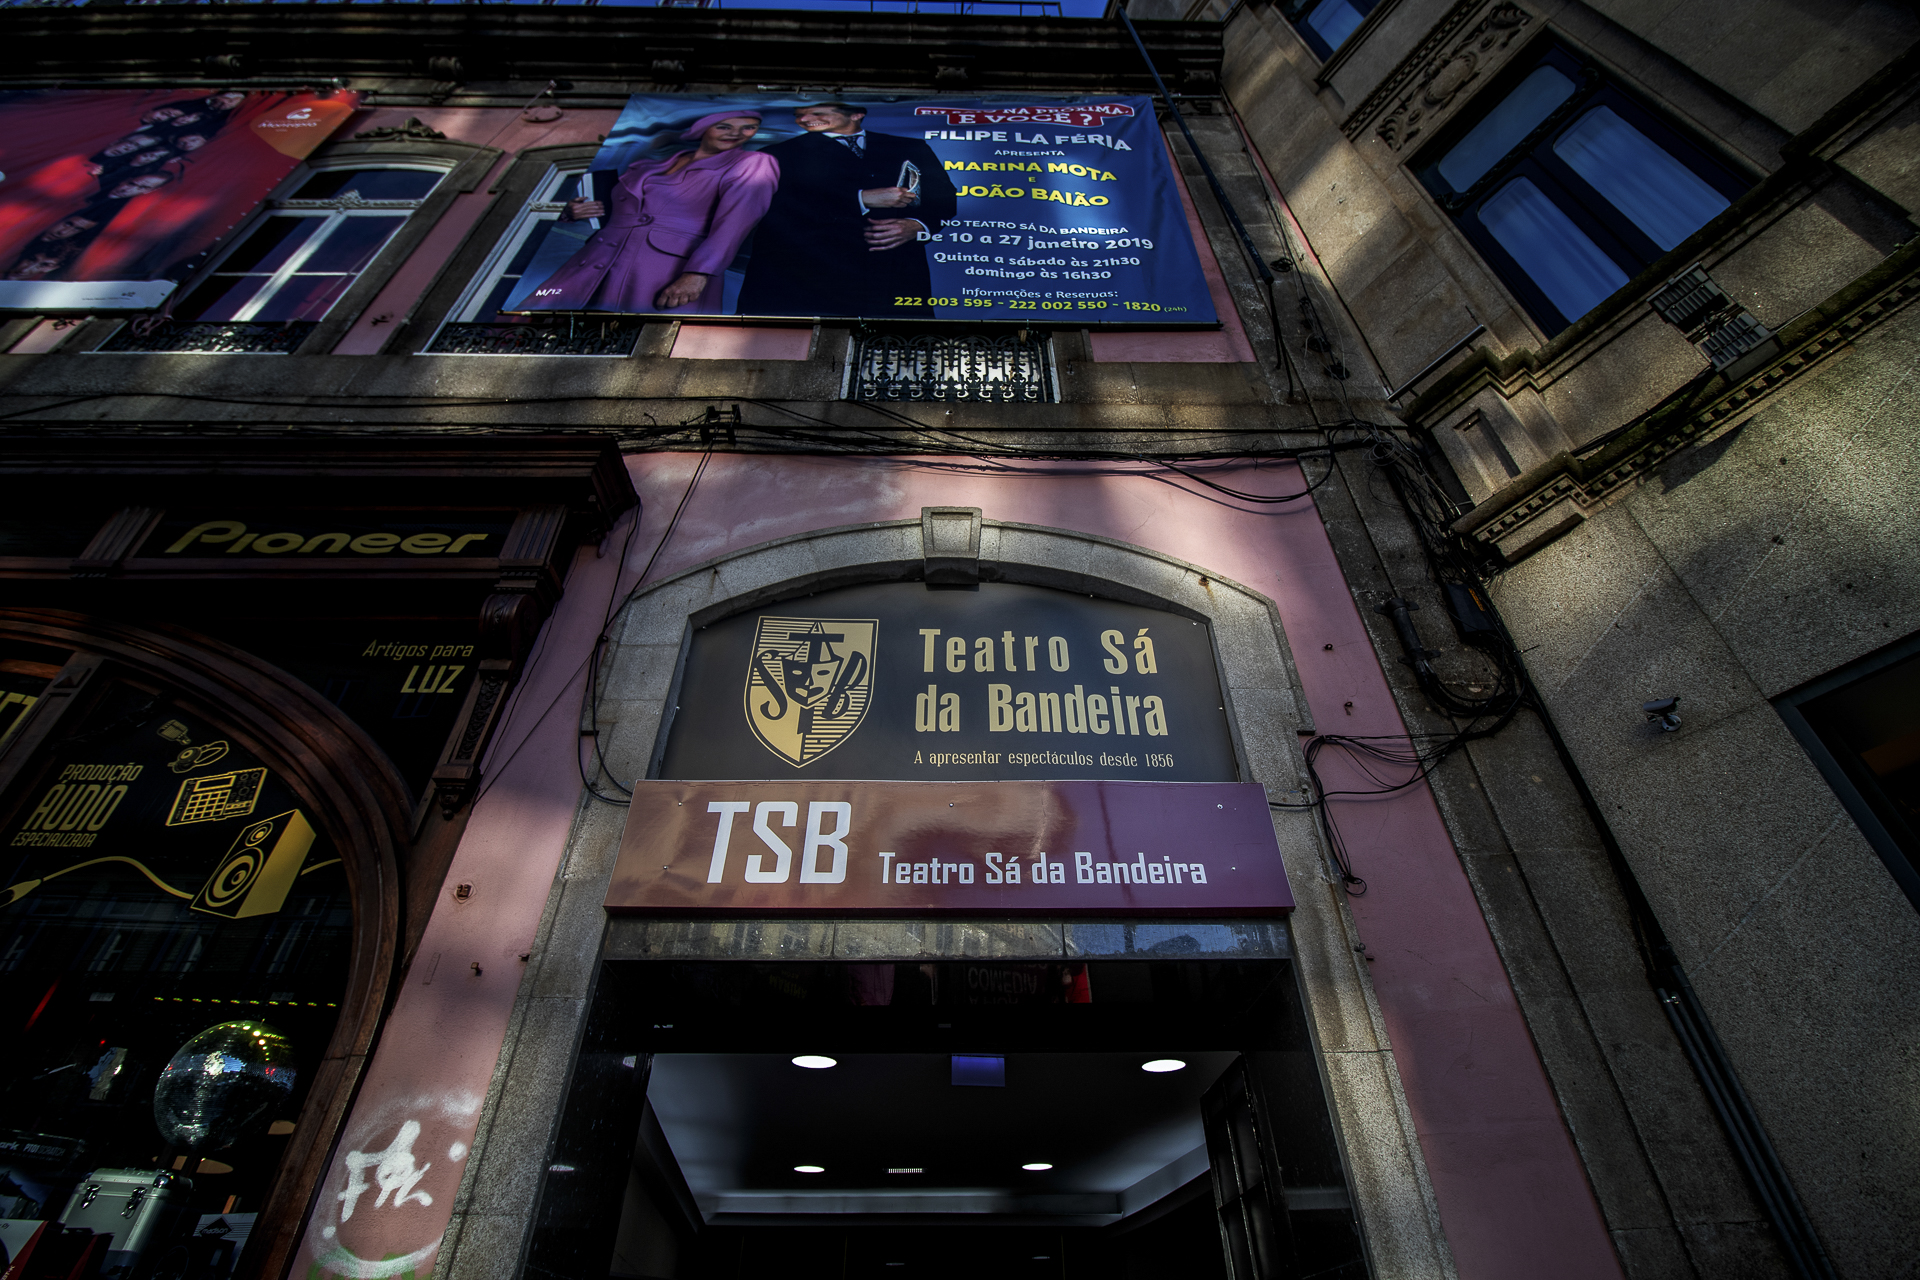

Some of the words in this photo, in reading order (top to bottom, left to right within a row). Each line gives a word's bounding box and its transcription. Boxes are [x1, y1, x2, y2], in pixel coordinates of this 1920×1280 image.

[958, 114, 976, 124] E
[984, 111, 1071, 124] VOCÊ
[1003, 107, 1031, 115] NA
[924, 130, 1008, 142] FILIPE
[1015, 132, 1049, 145] LA
[1055, 133, 1132, 151] FÉRIA
[944, 160, 1043, 173] MARINA
[1047, 162, 1118, 182] MOTA
[955, 183, 1025, 199] JOÃO
[1032, 187, 1109, 207] BAIÃO
[940, 219, 961, 227] NO
[963, 220, 1016, 229] TEATRO
[1019, 220, 1035, 230] SÁ
[1039, 225, 1057, 235] DA
[1060, 226, 1129, 236] BANDEIRA
[916, 230, 943, 243] De
[949, 232, 974, 244] 10
[980, 235, 993, 245] a
[998, 234, 1022, 247] 27
[1027, 235, 1099, 251] janeiro
[1105, 237, 1154, 250] 2019
[933, 251, 990, 265] Quinta
[994, 256, 1005, 264] a
[1008, 254, 1066, 267] sábado
[1070, 256, 1090, 268] às
[1093, 256, 1140, 268] 21h30
[964, 266, 1035, 280] domingo
[1040, 267, 1058, 280] às
[1062, 269, 1112, 280] 16h30
[535, 288, 563, 297] M/12
[961, 287, 1042, 301] Informações
[1045, 291, 1053, 299] e
[1056, 290, 1119, 299] Reservas:
[893, 297, 923, 307] 222
[927, 297, 958, 307] 003
[963, 297, 993, 308] 595
[1008, 299, 1037, 310] 222
[1041, 300, 1071, 310] 002
[1075, 300, 1108, 311] 550
[1123, 301, 1161, 313] 1820
[1164, 305, 1187, 314] (24h)
[164, 520, 489, 555] Pioneer
[361, 638, 428, 661] Artigos
[429, 644, 475, 661] para
[918, 628, 1070, 673] Teatro
[1100, 627, 1158, 675] Sá
[400, 665, 466, 693] LUZ
[914, 684, 961, 733] da
[987, 683, 1169, 737] Bandeira
[913, 750, 924, 765] A
[929, 750, 1002, 767] apresentar
[1007, 750, 1094, 767] espectáculos
[1099, 751, 1138, 767] desde
[1145, 753, 1174, 768] 1856
[57, 762, 145, 785] PRODUÇÃO
[21, 779, 129, 831] ÁUDIO
[9, 831, 98, 848] ESPECIALIZADA
[706, 801, 853, 885] TSB
[878, 851, 975, 885] Teatro
[985, 850, 1021, 885] Sá
[1031, 851, 1066, 885] da
[1074, 851, 1208, 885] Bandeira
